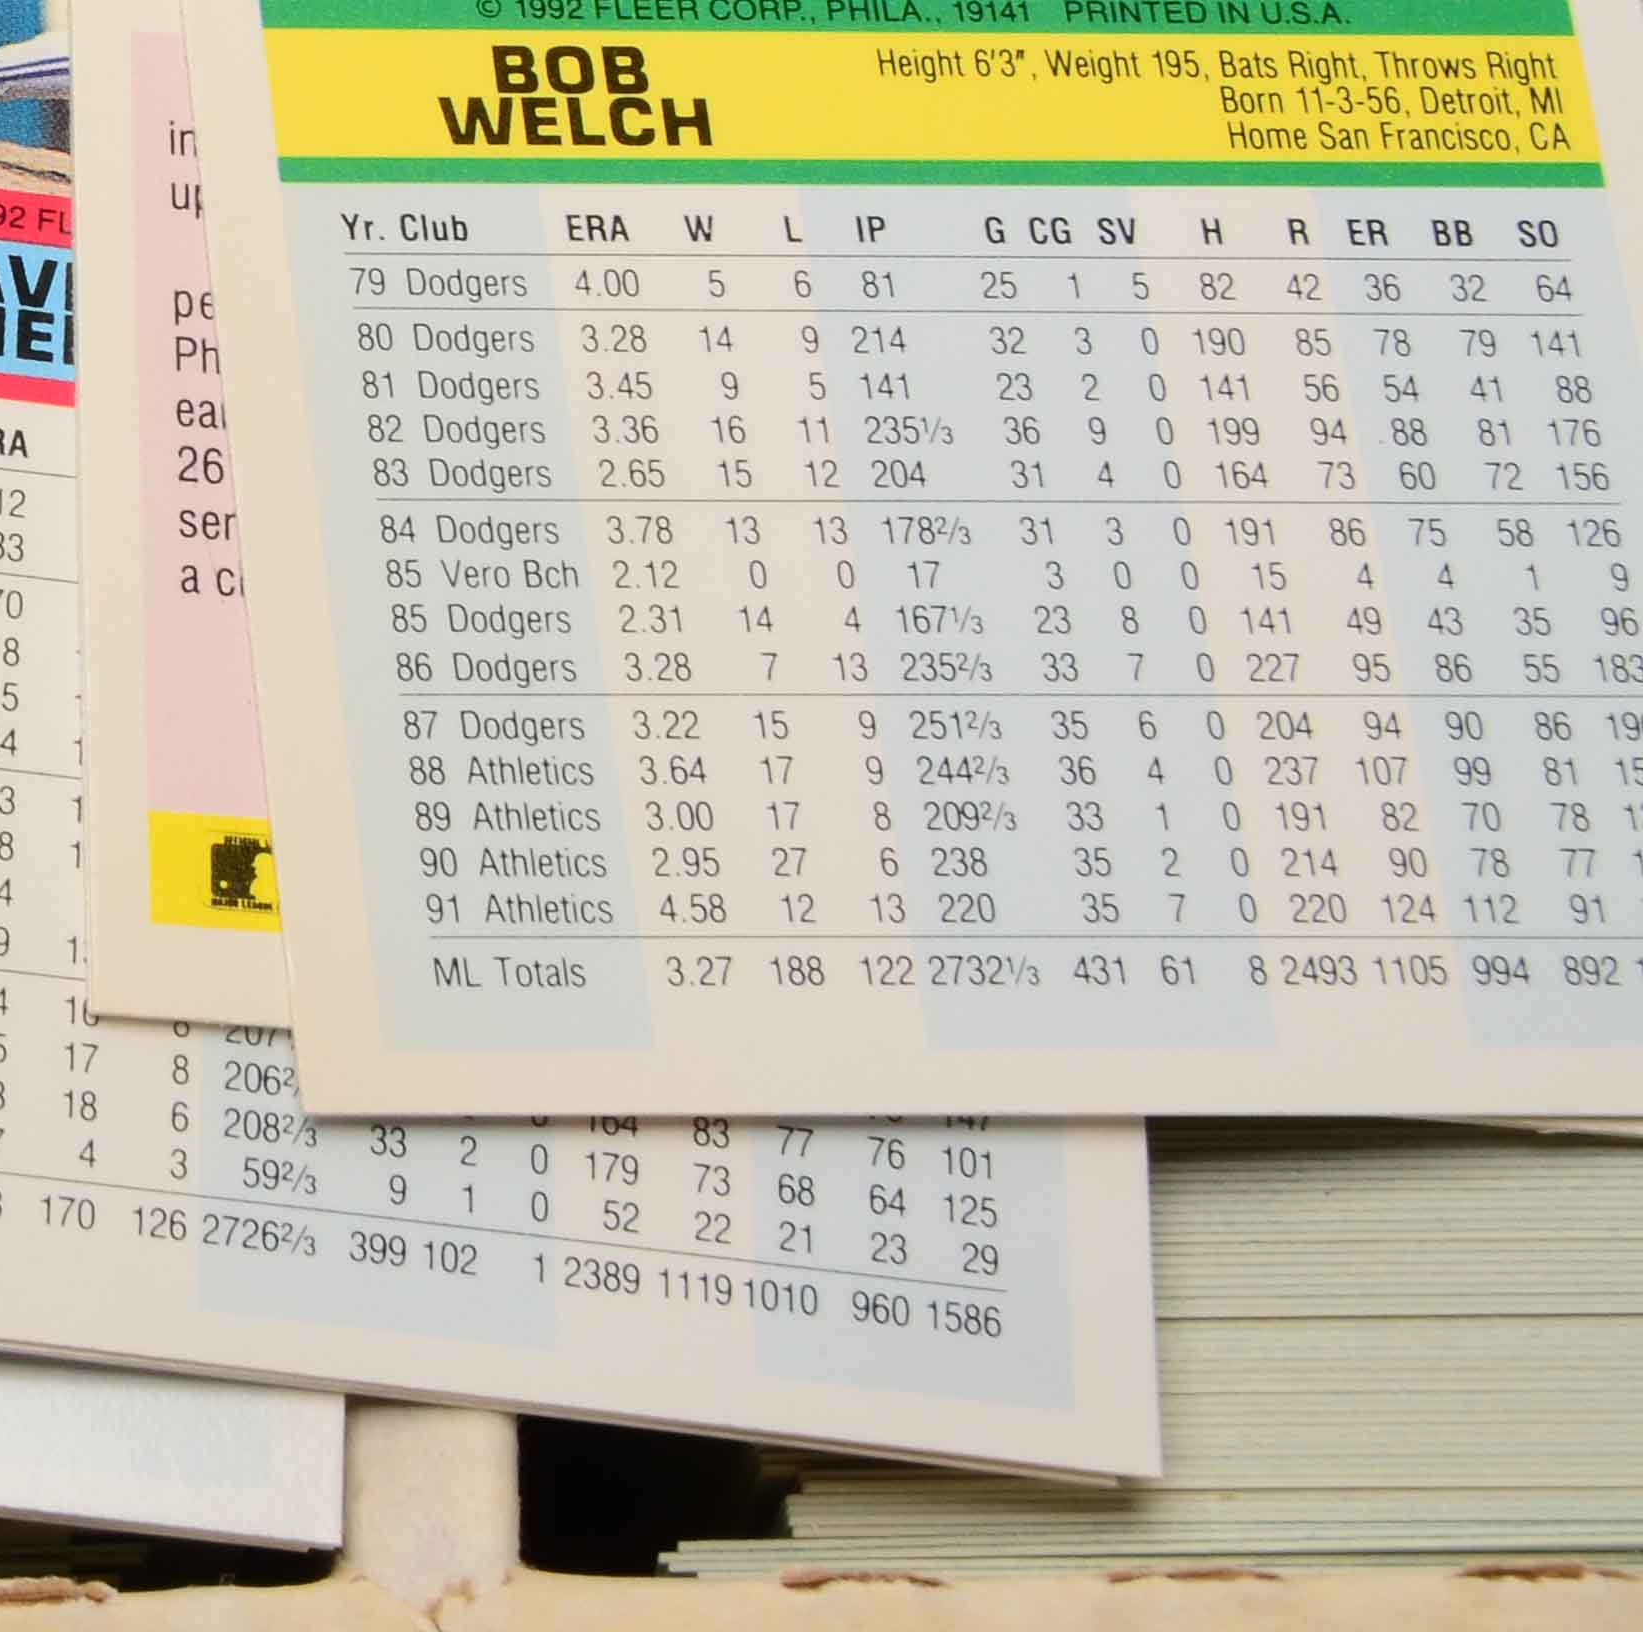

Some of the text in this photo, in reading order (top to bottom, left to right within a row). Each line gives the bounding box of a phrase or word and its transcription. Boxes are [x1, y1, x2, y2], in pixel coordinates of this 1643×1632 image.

[952, 0, 1030, 23] 19141
[1064, 0, 1208, 24] PRINTED
[1217, 1, 1251, 25] IN
[1260, 0, 1351, 25] U.S.A.
[491, 44, 649, 95] BOB
[875, 47, 964, 83] Height
[1043, 48, 1140, 85] Weight
[1151, 48, 1210, 82] 195,
[1217, 48, 1279, 79] Bats
[1287, 49, 1367, 87] Right,
[1376, 50, 1477, 79] Throws
[1485, 50, 1558, 86] Right
[1219, 79, 1564, 119] Born 11-3-56, Detroit, MI
[437, 95, 713, 146] WELCH
[1226, 120, 1571, 154] Home San Francisco, CA
[337, 210, 1562, 250] Yr. Club ERA W L IP G CG SV H R ER BB SO
[347, 265, 642, 304] 79 Dodgers 4.00
[177, 446, 225, 484] 26
[180, 565, 200, 594] a
[417, 844, 722, 880] 90 Athletics 2.95
[562, 1253, 643, 1297] 2389
[849, 1287, 913, 1329] 960
[925, 1297, 1004, 1340] 1586
